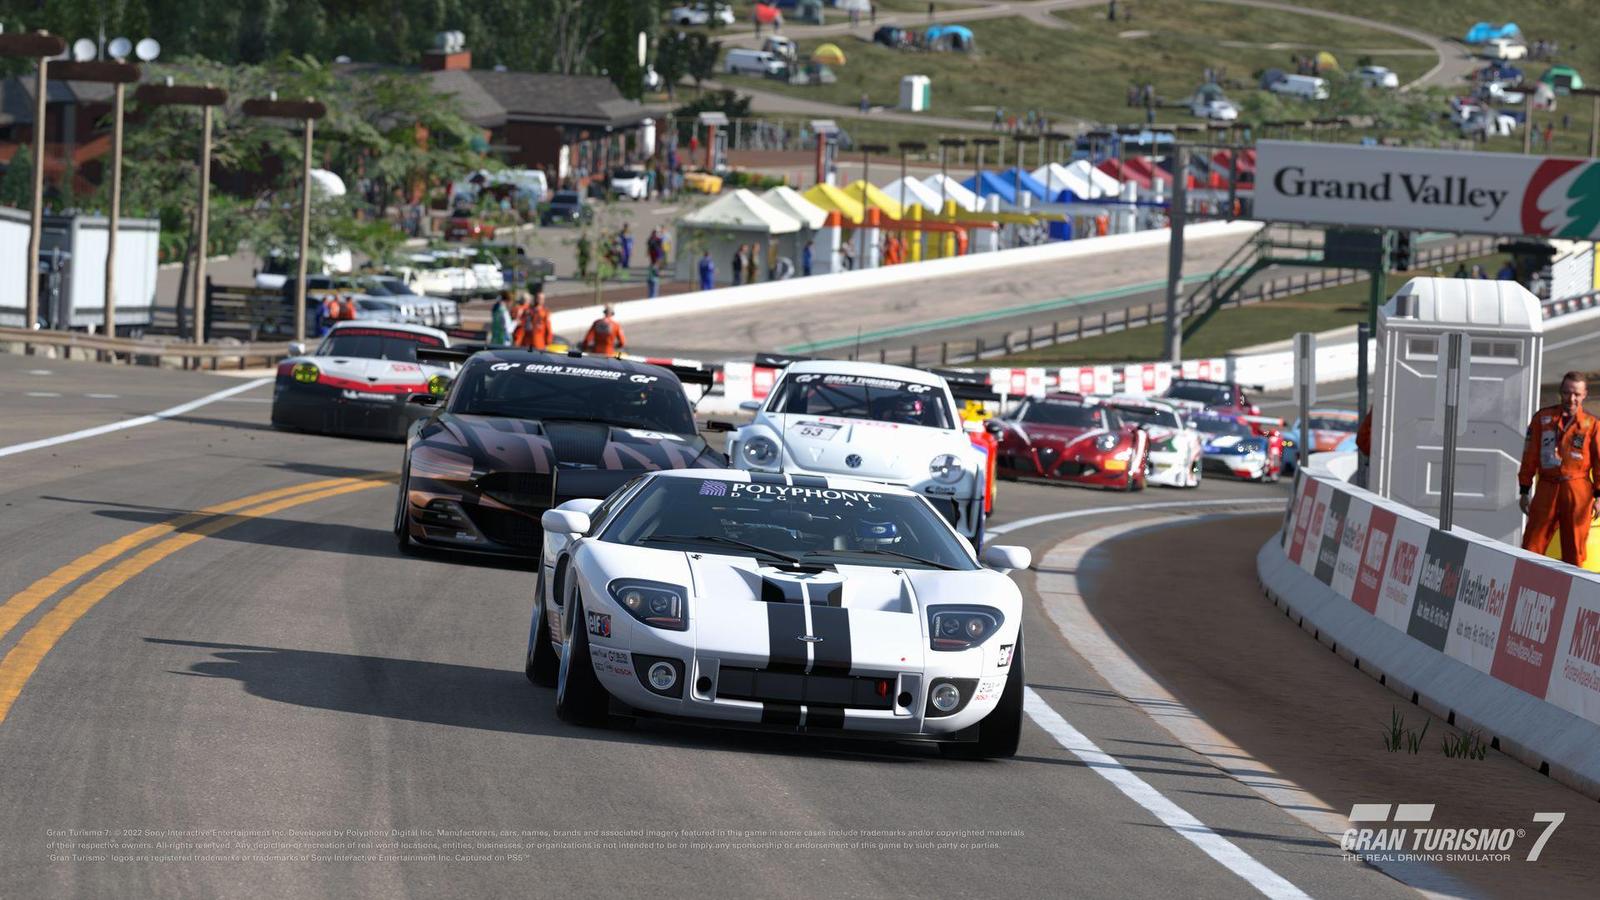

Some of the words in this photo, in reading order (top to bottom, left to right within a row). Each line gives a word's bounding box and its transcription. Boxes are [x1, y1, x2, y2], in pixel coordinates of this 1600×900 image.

[1273, 166, 1393, 201] Grand
[1398, 173, 1510, 222] Valley
[525, 364, 554, 373] GRAN
[564, 366, 625, 378] TURISMO
[800, 427, 823, 437] 53
[730, 492, 876, 509] DIGITAL
[1459, 568, 1506, 619] WeatherTech
[1510, 586, 1556, 645] MOTHERS
